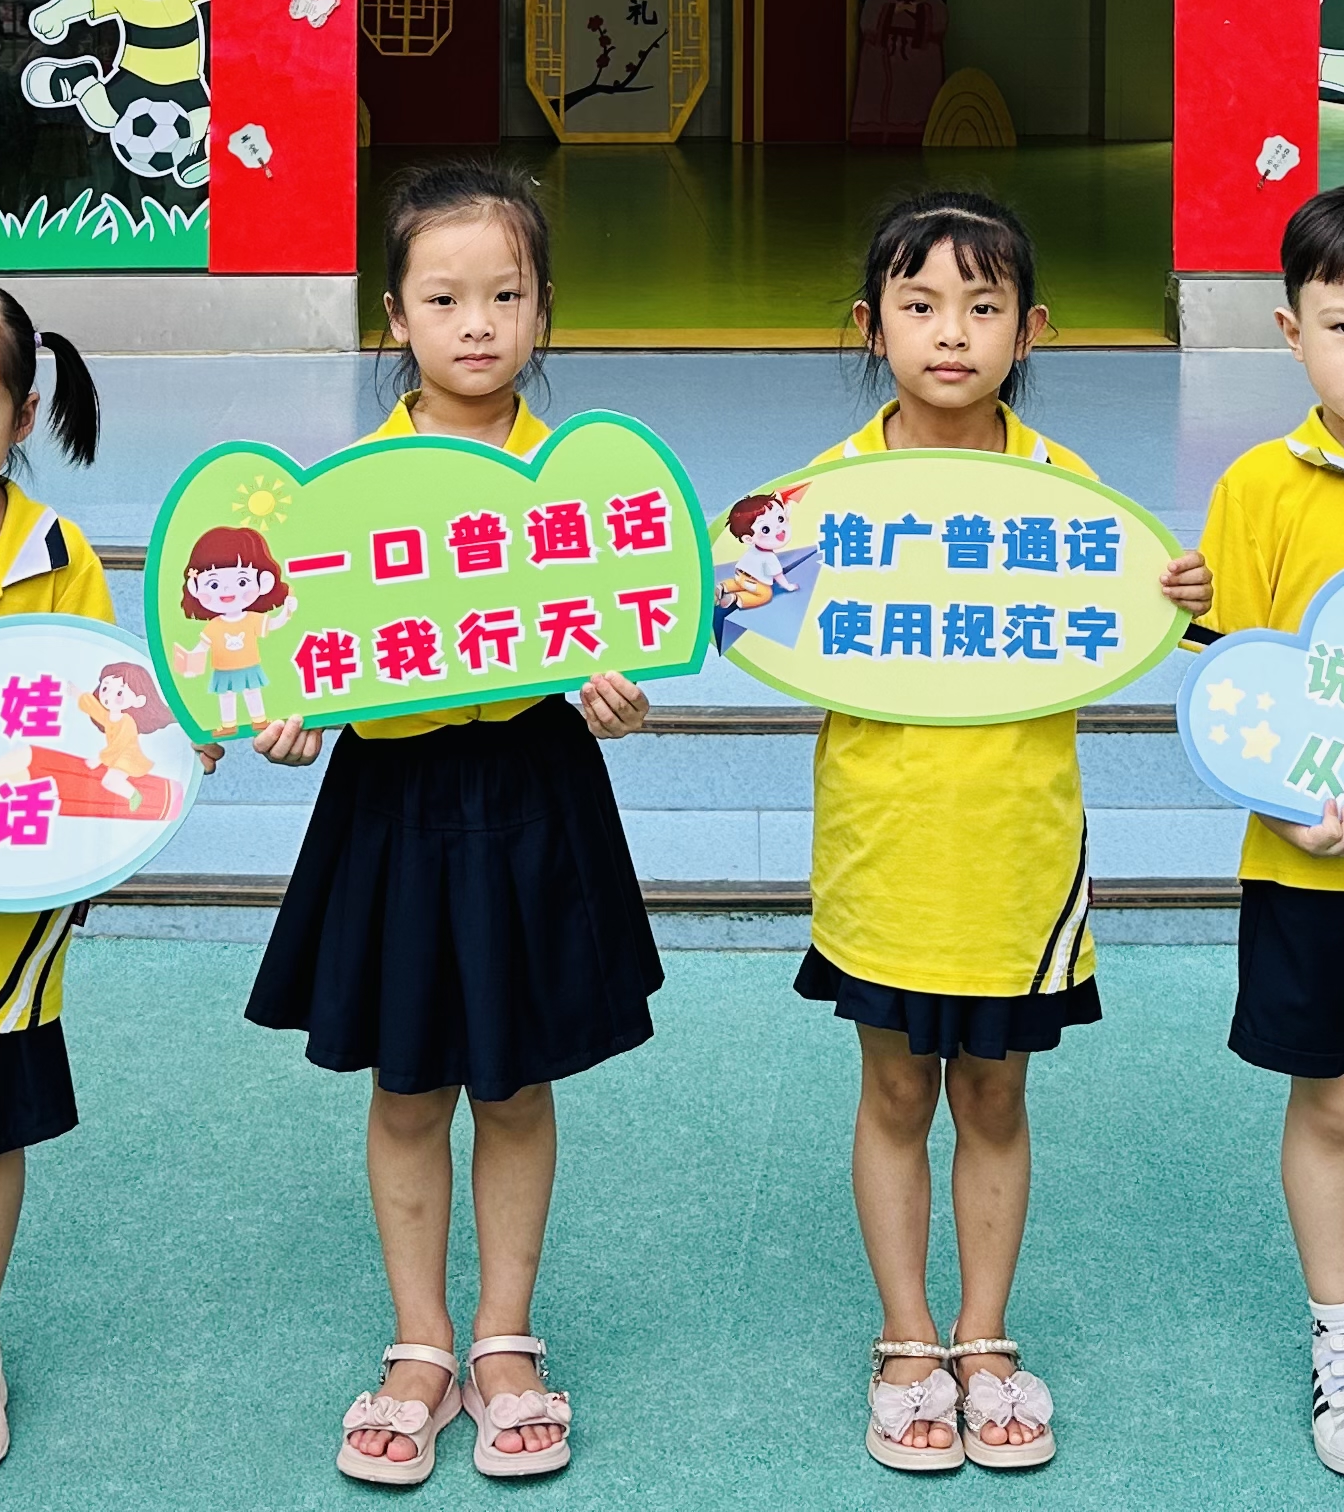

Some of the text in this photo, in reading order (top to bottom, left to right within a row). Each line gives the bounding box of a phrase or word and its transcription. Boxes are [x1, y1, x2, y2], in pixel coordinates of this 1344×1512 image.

[286, 488, 673, 580] 一口普通话
[817, 511, 1122, 574] 推广普通话
[293, 585, 678, 696] 伴我行天下
[817, 598, 1120, 662] 使用规范字
